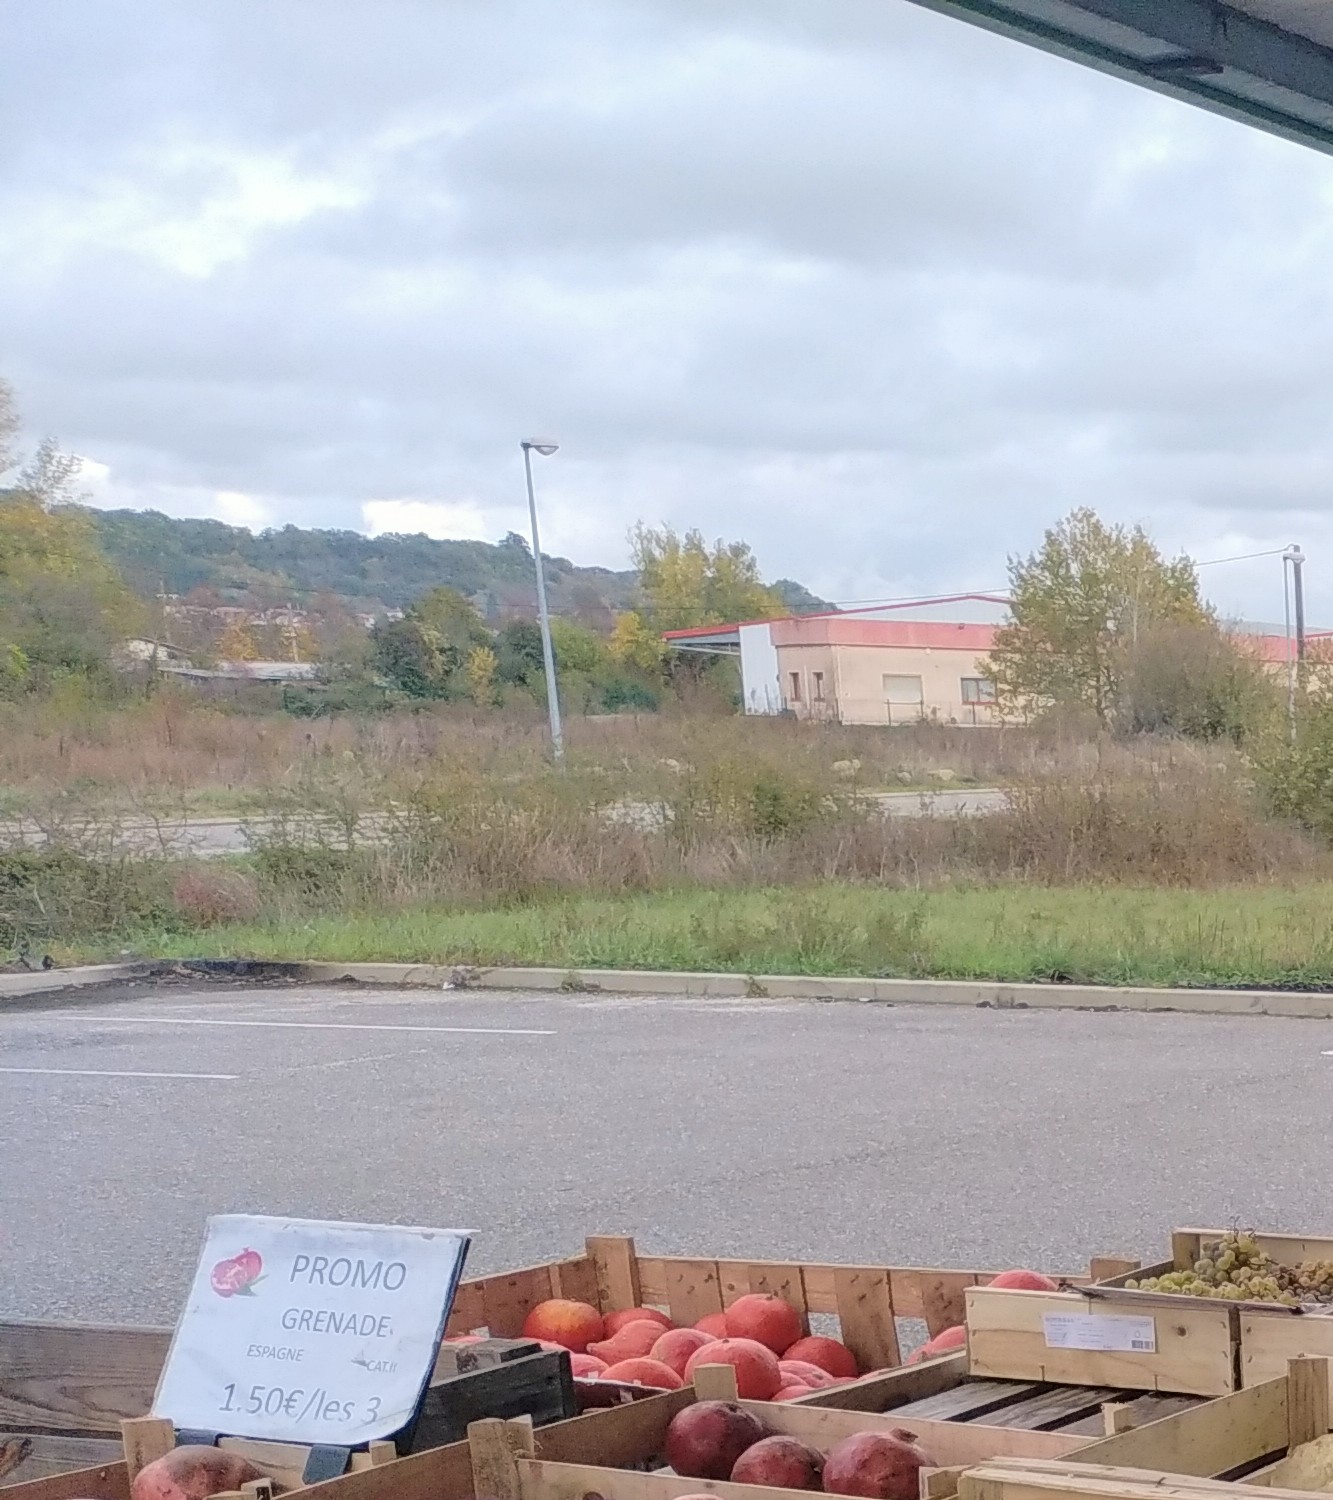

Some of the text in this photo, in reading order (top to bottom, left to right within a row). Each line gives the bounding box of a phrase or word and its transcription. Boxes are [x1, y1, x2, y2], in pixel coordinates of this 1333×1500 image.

[290, 1254, 407, 1291] PROMO
[282, 1308, 392, 1338] GRENADE
[246, 1344, 304, 1362] ESPAGNE
[218, 1383, 382, 1424] 1.50€/les 3
